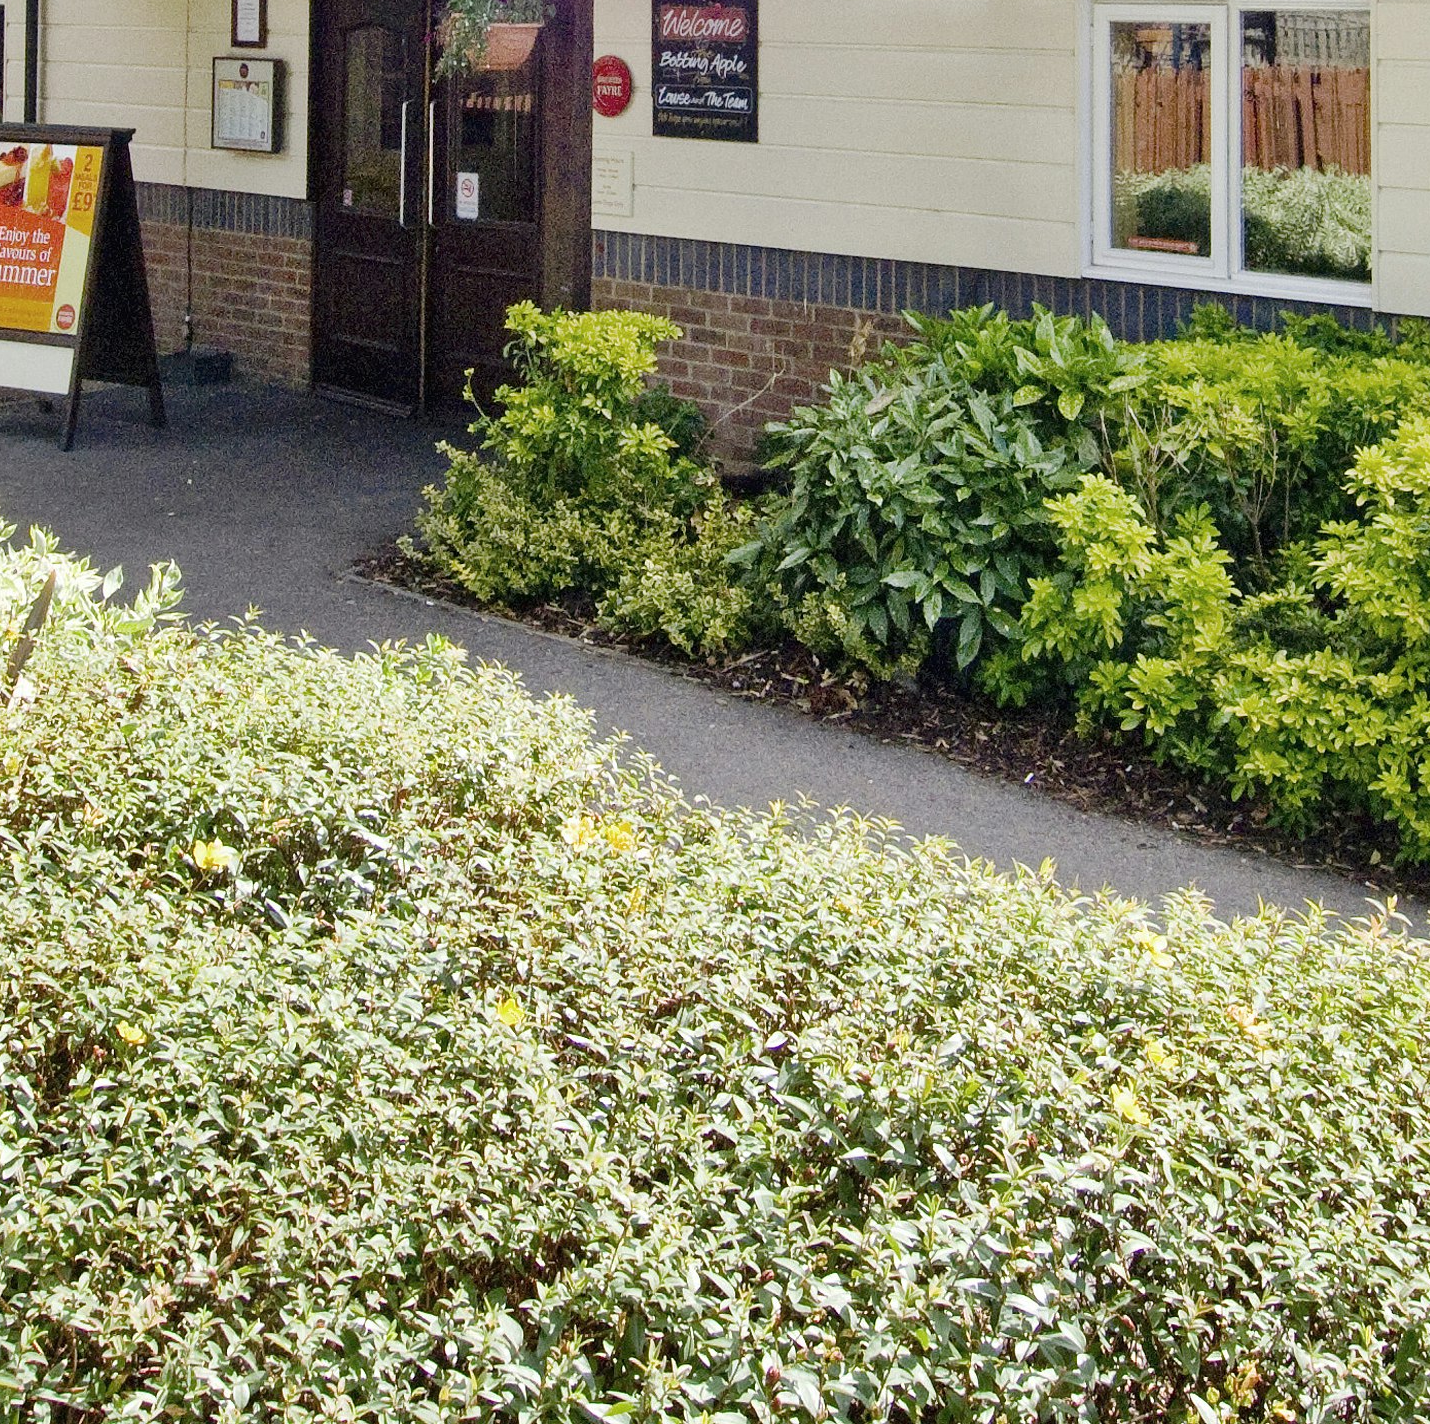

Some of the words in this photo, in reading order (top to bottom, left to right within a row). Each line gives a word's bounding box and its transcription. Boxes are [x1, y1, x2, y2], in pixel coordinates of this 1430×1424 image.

[663, 9, 744, 37] Welcome
[659, 51, 709, 75] Bobbing
[710, 53, 747, 79] Apple
[704, 91, 724, 108] The
[723, 92, 749, 110] Team
[83, 154, 94, 173] 2
[72, 191, 93, 212] £9
[32, 228, 51, 244] the
[39, 247, 53, 262] of
